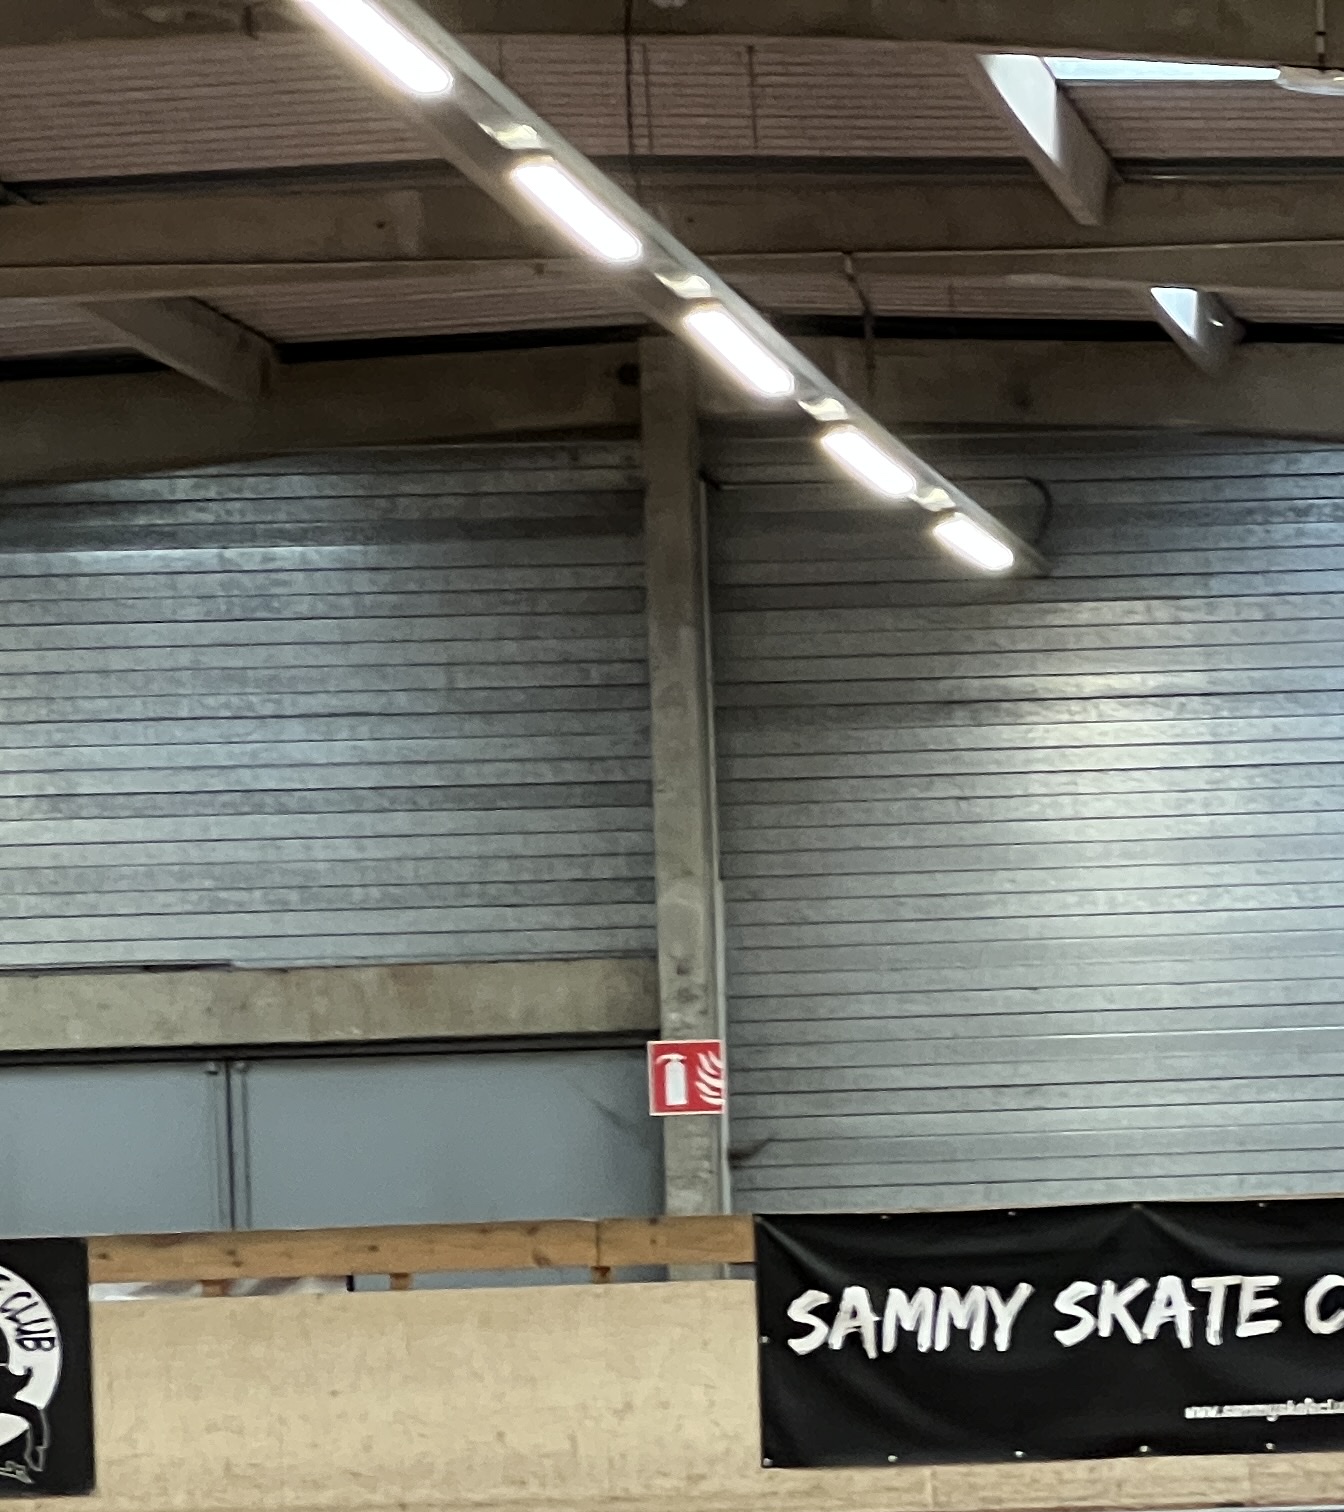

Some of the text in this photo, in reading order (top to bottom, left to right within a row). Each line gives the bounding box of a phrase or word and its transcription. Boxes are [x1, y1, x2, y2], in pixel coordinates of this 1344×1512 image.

[0, 1291, 56, 1352] CLUB
[786, 1282, 1035, 1359] SAMMY
[1053, 1274, 1283, 1349] SKATE
